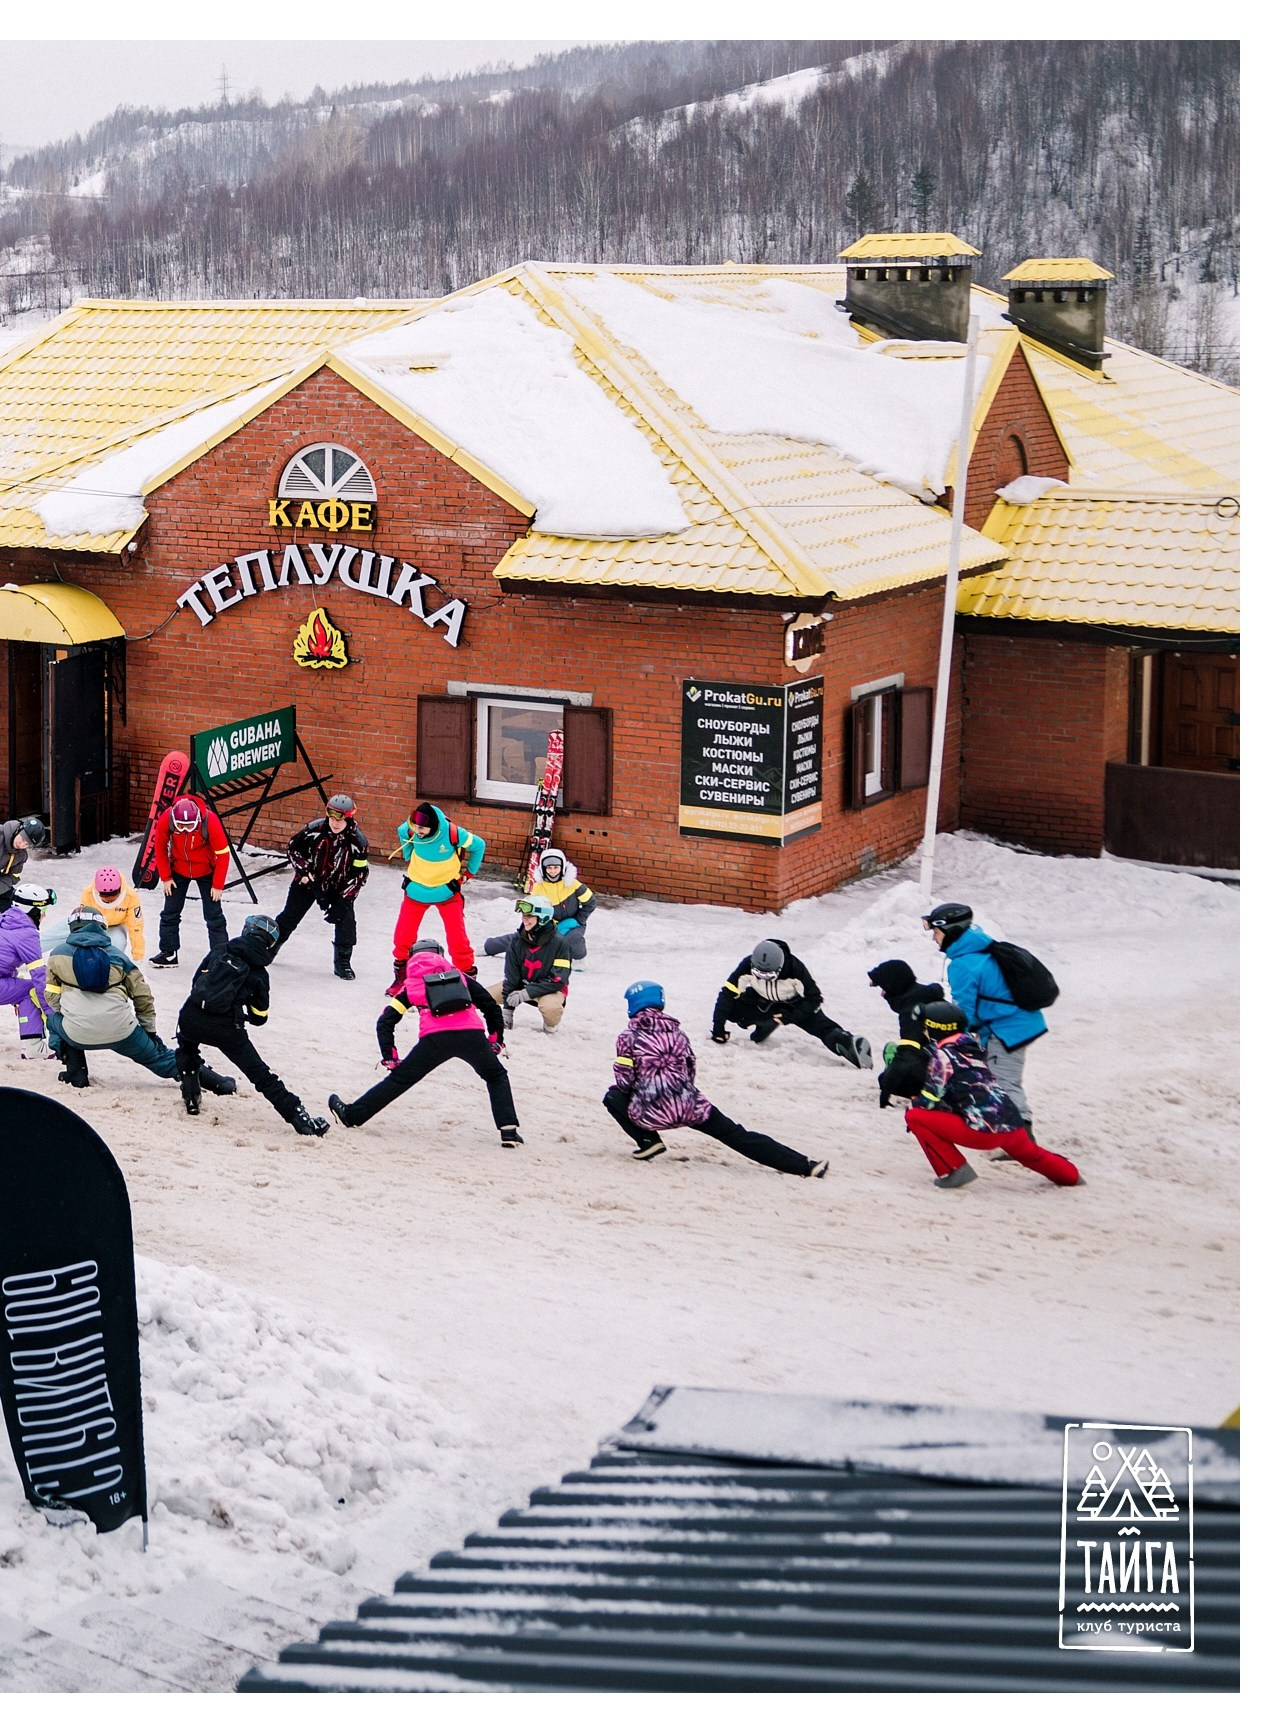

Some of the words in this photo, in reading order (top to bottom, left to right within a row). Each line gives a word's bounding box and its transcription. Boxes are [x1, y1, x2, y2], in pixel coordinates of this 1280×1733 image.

[268, 498, 373, 532] КАФЕ
[176, 543, 468, 647] ТЕПЛУШКА
[704, 689, 782, 707] ProkatGu.ru
[230, 719, 281, 749] GUBAHA
[697, 718, 770, 736] СНОУБОРДЫ
[713, 734, 753, 747] ЛЫЖИ
[230, 741, 282, 771] BREWERY
[702, 747, 764, 763] КОСТЮМЫ
[711, 762, 753, 776] МАСКИ
[695, 775, 770, 792] СКИ-СЕРВИС
[700, 790, 765, 806] СУВЕНИРЫ
[1, 1259, 102, 1340] 109
[10, 1331, 123, 1501] СТУДИЯ
[108, 1490, 128, 1506] 18+
